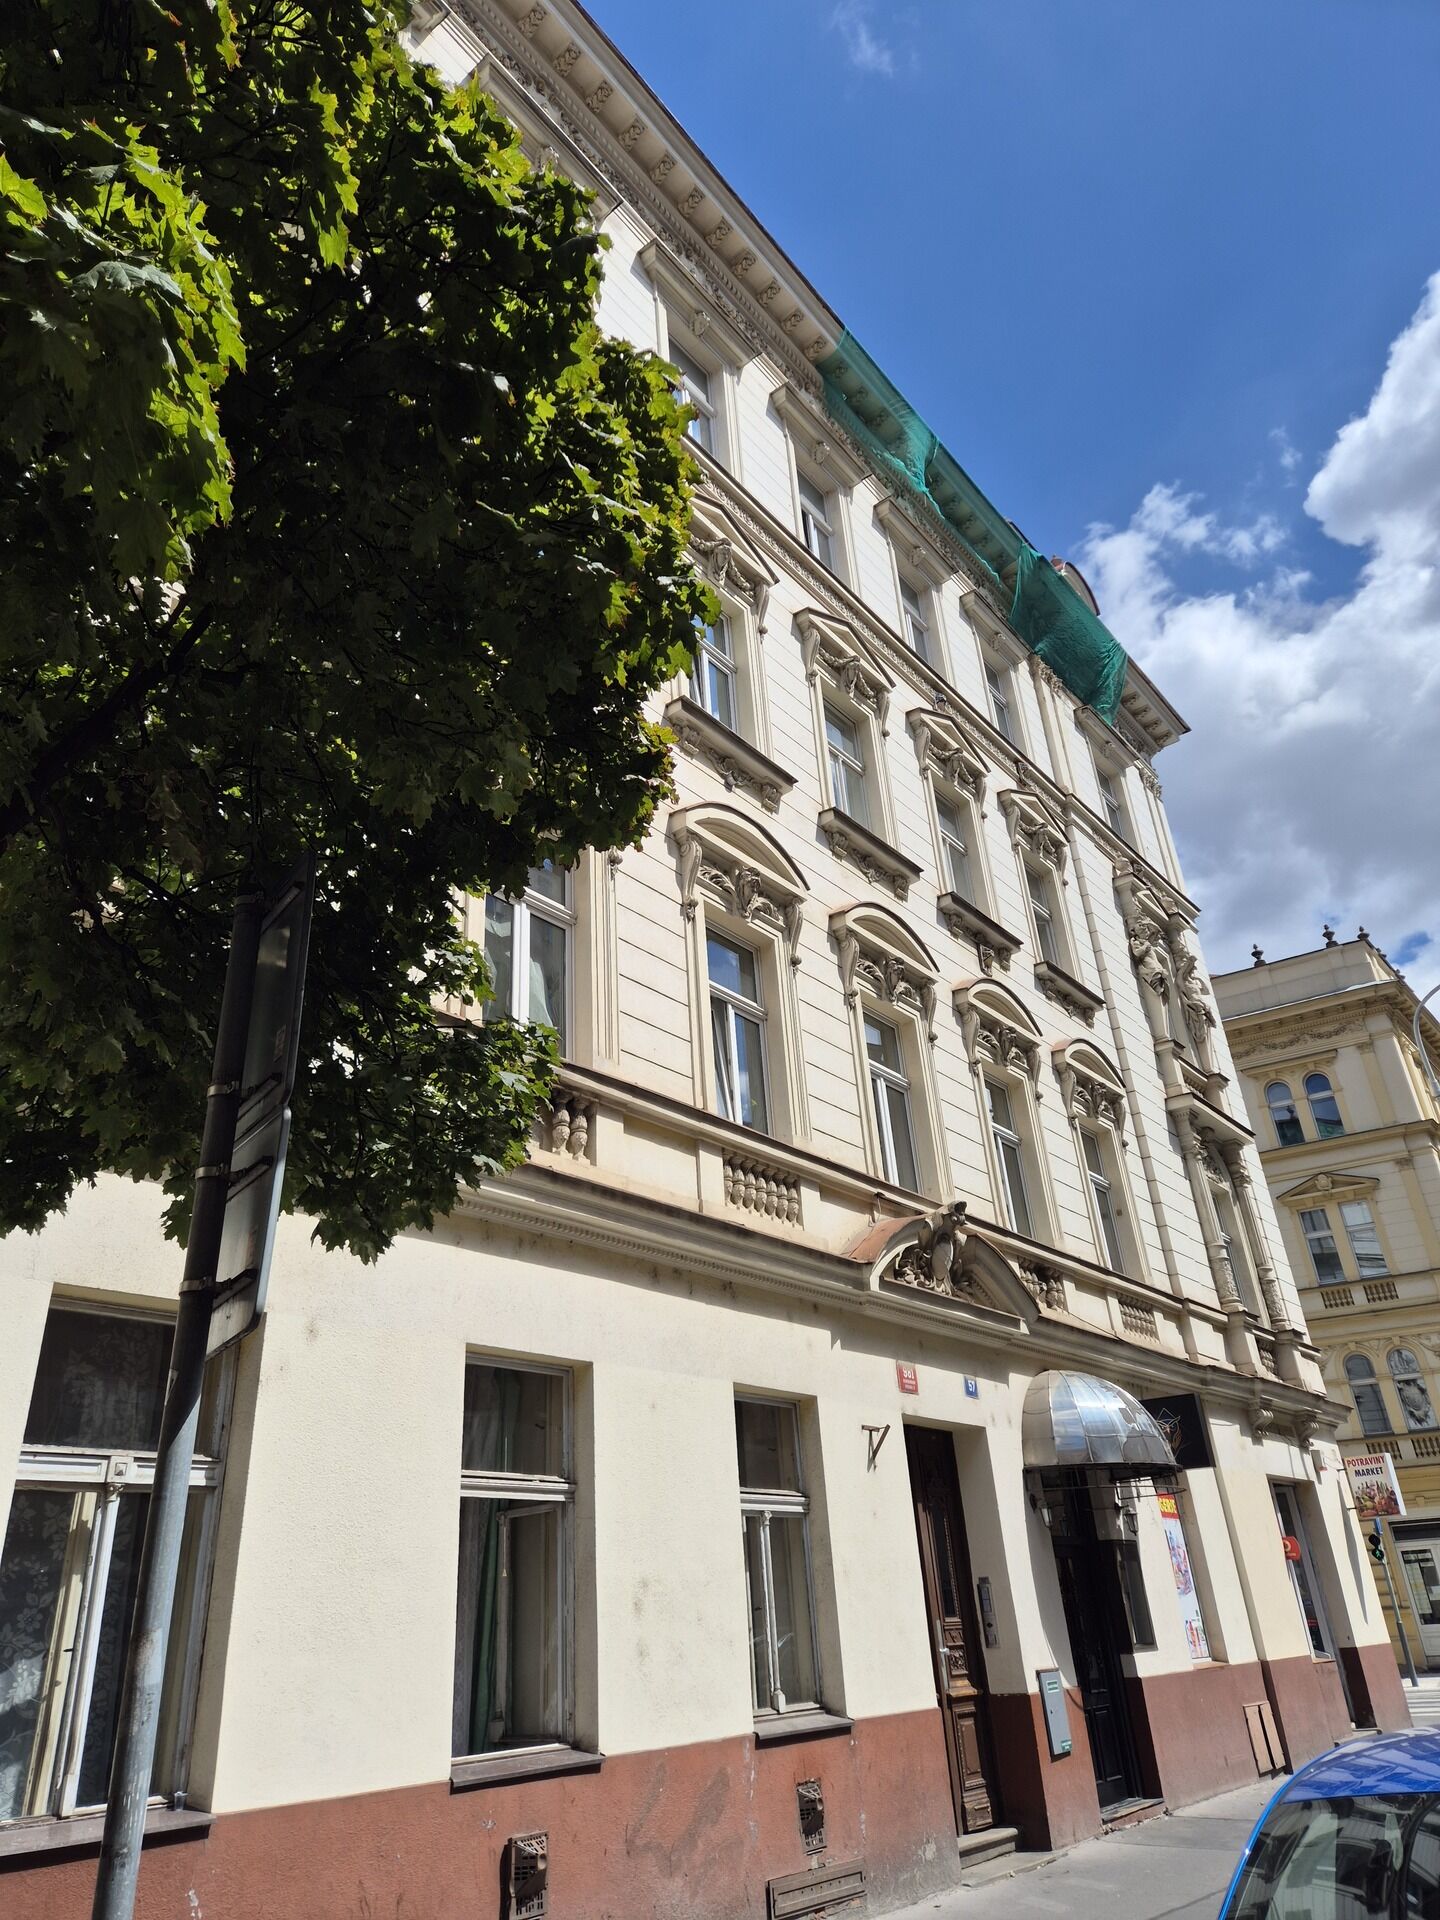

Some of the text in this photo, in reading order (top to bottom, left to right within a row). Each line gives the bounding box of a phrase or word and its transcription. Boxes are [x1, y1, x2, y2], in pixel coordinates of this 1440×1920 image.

[967, 1380, 975, 1392] 57
[1346, 1456, 1385, 1468] POTRAVINY
[1354, 1467, 1384, 1477] MARKET
